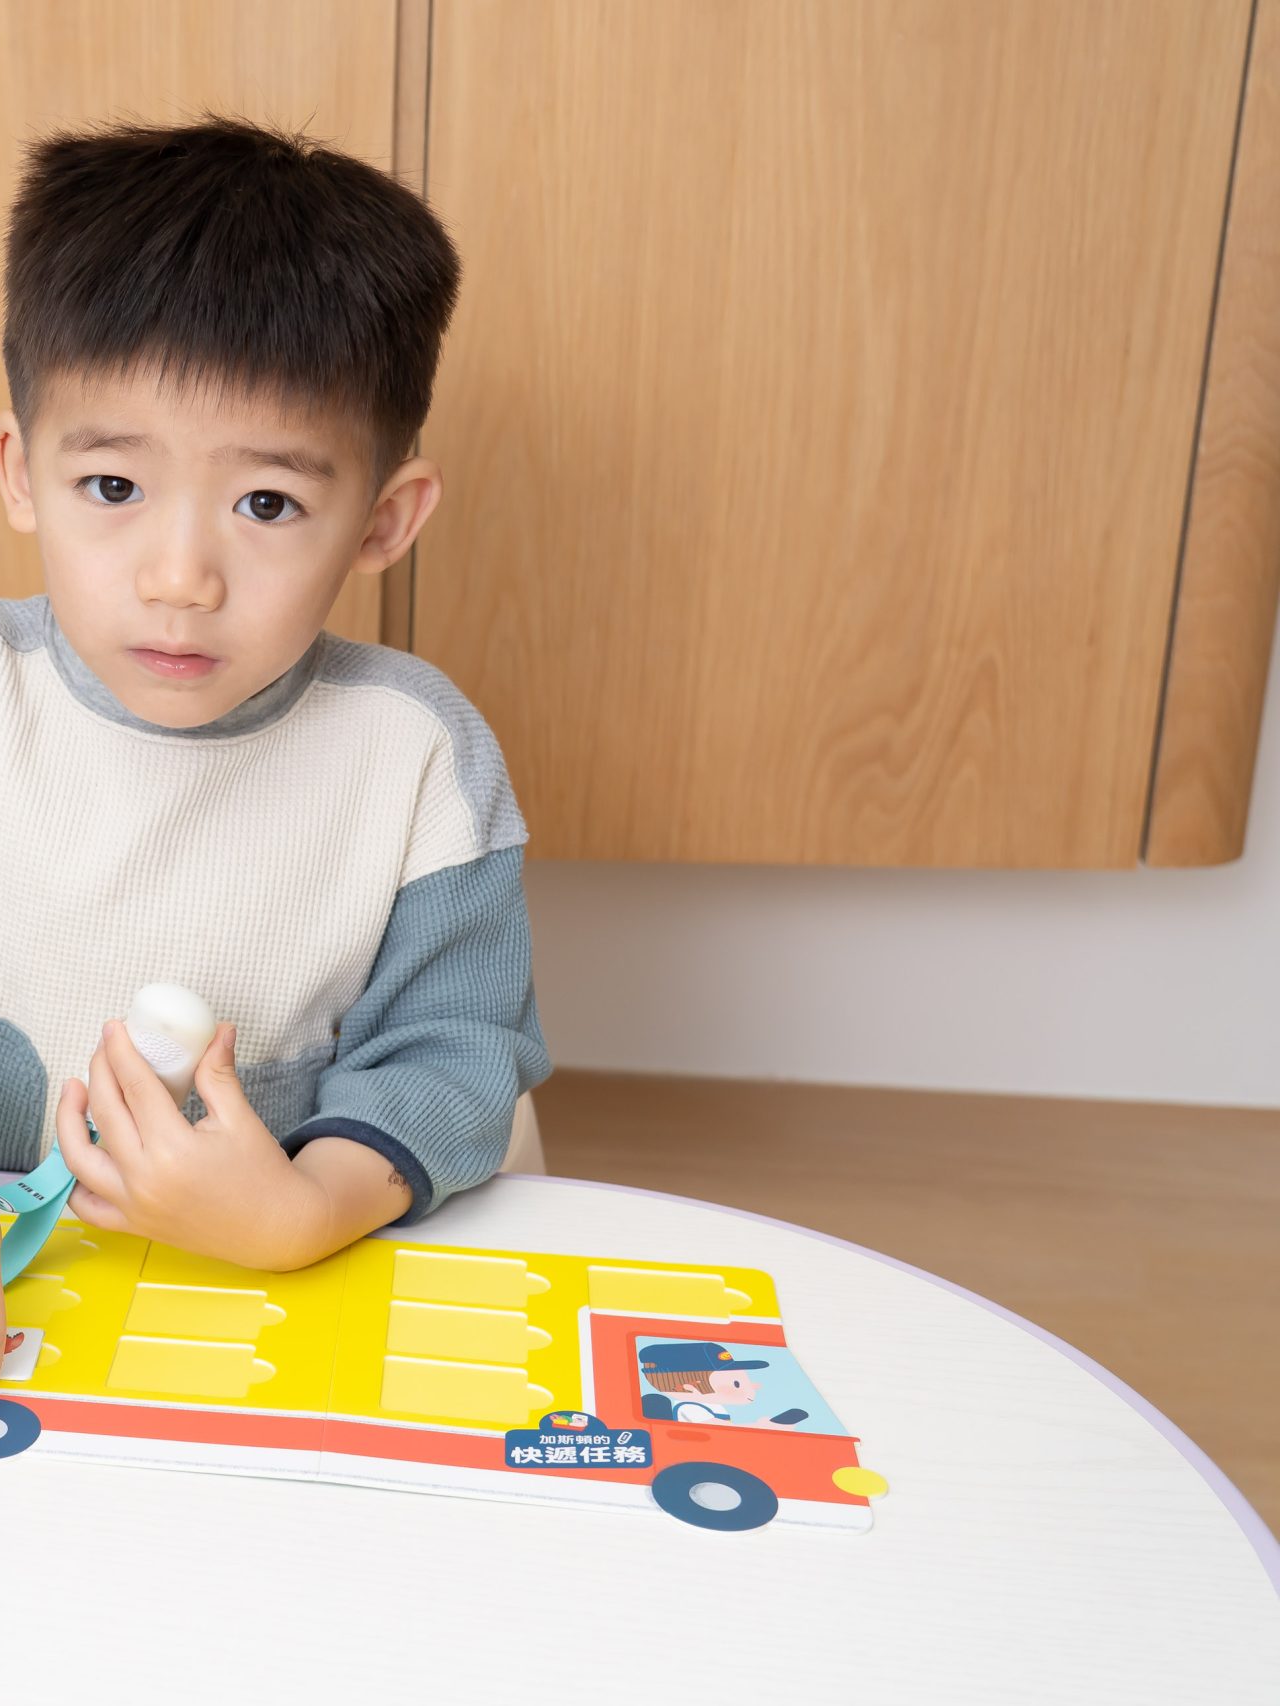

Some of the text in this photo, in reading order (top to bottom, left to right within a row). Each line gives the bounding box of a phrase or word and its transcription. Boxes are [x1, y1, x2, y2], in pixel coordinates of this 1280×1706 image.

[539, 1434, 610, 1445] 加斯頓的
[510, 1446, 646, 1464] 快遞任務
